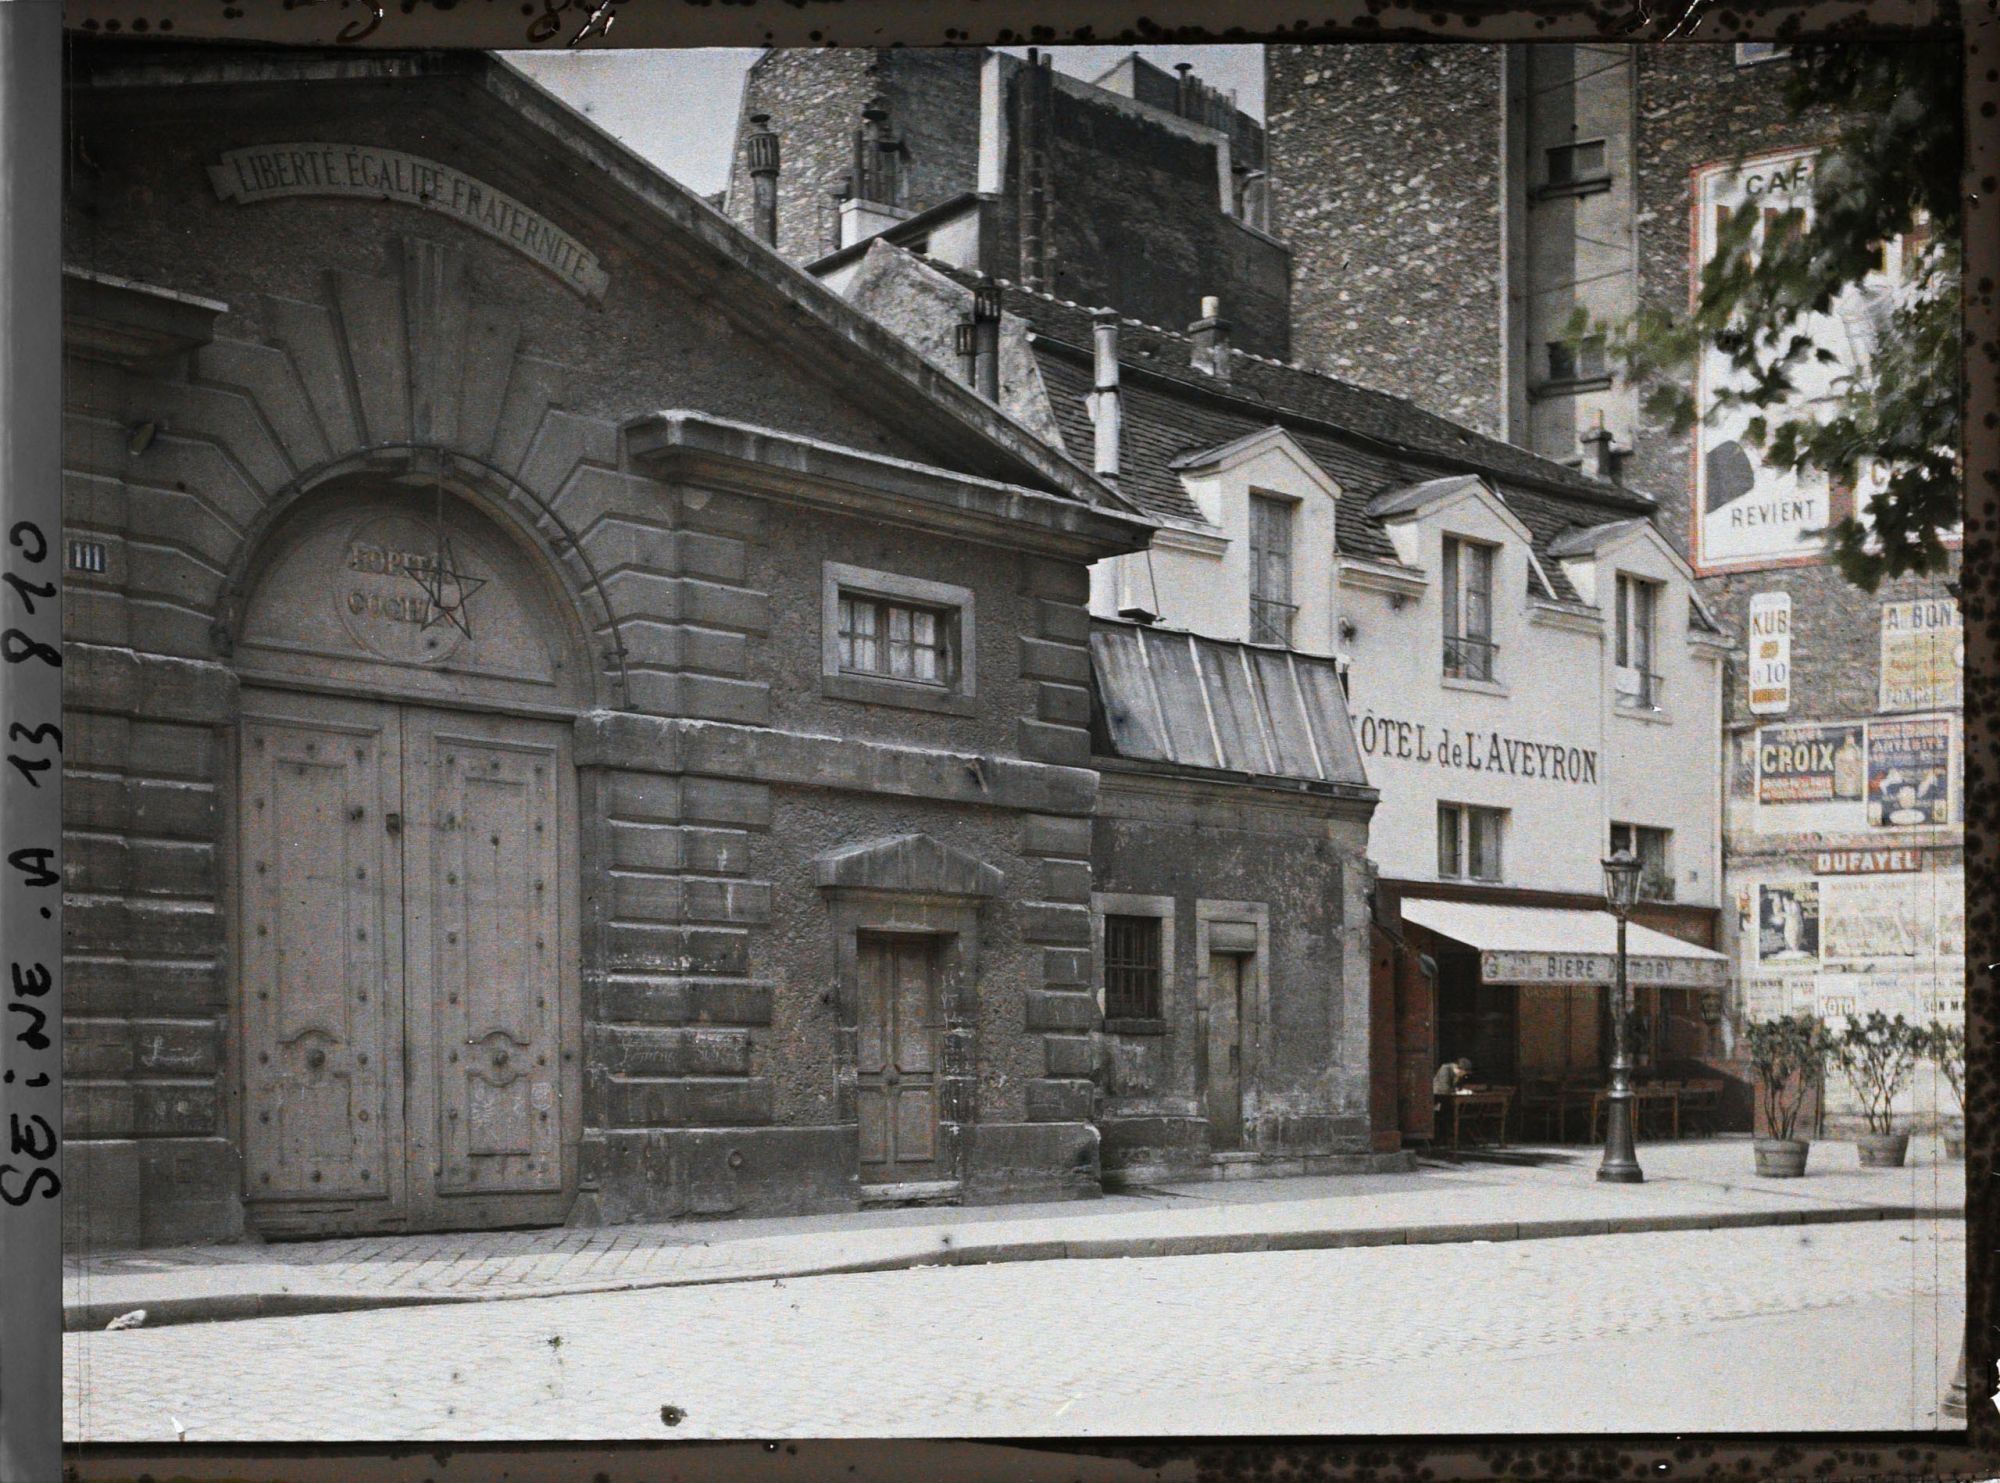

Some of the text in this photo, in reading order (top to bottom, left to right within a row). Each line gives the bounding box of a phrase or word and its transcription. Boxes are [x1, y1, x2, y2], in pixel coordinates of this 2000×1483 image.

[1745, 165, 1807, 196] CAF
[451, 178, 590, 284] FRATERNITÉ
[1730, 501, 1815, 529] REVIENT
[74, 542, 101, 571] 111
[3, 520, 61, 669] 810
[1752, 609, 1788, 636] KUB
[7, 721, 61, 789] 13
[1351, 709, 1598, 784] ÔTEL de L'AVEYRON
[1761, 743, 1834, 774] CROIX
[1817, 851, 1917, 873] DUFAYEL
